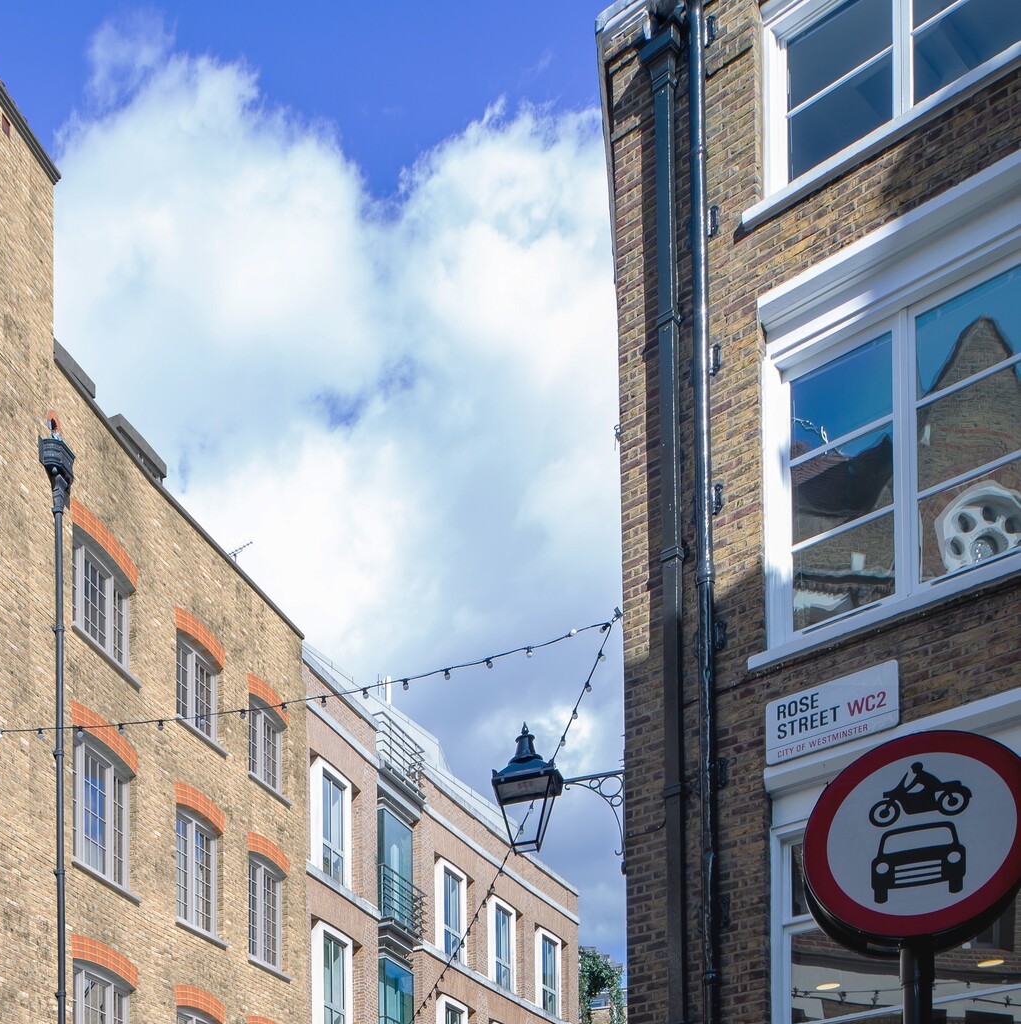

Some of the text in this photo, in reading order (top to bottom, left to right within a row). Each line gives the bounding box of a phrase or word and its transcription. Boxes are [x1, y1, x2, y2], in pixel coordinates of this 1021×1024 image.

[777, 692, 819, 721] ROSE
[777, 691, 886, 739] STREET WC2
[777, 723, 868, 759] CITY OF WESTMINSTER
